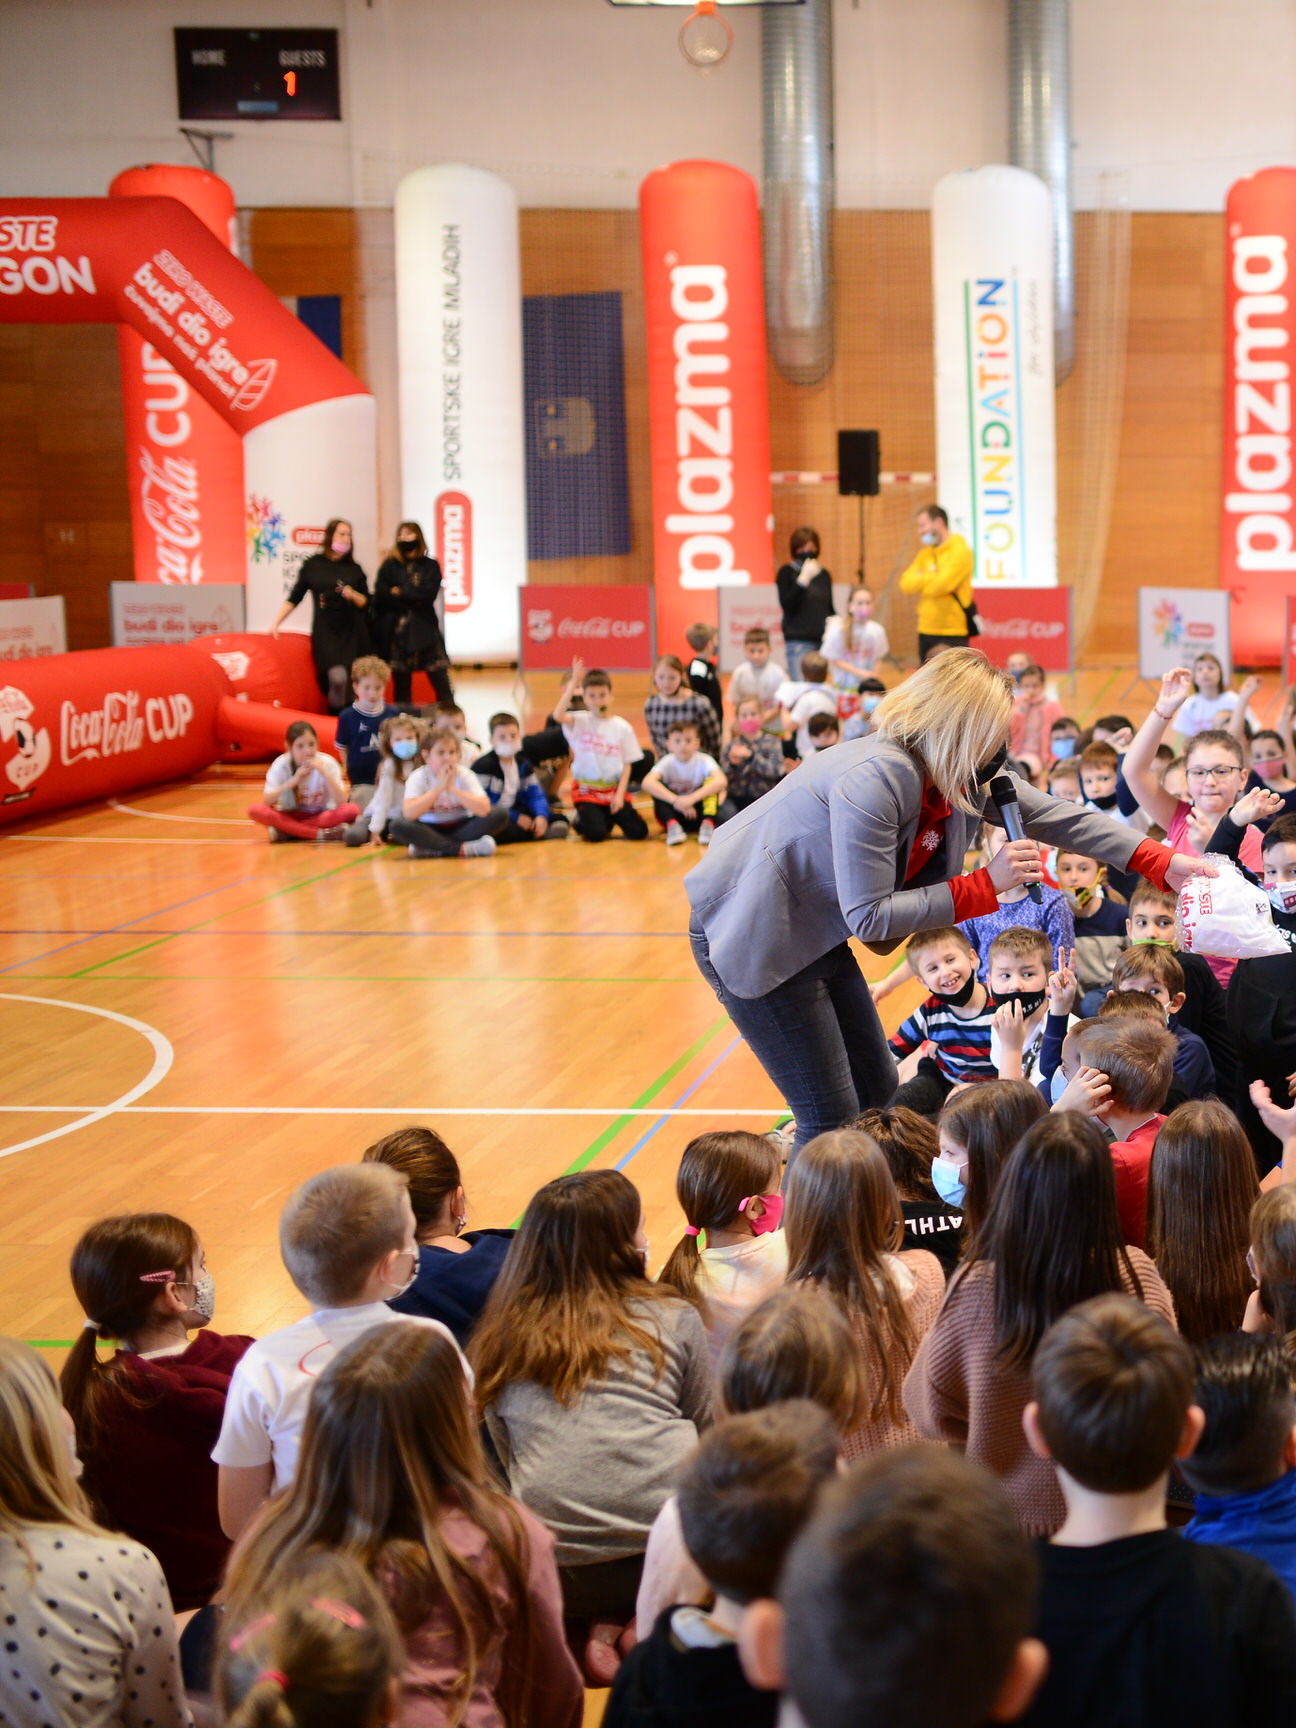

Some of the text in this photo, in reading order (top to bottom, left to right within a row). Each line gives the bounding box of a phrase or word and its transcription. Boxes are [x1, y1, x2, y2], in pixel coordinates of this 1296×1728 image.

[283, 71, 297, 97] 1
[0, 256, 97, 295] GON
[133, 262, 250, 385] budi dio igre
[442, 224, 463, 482] SPORTSKE IGRE MLADIH
[665, 264, 751, 590] plazma
[440, 503, 470, 607] plazma
[612, 619, 645, 638] CUP
[61, 690, 144, 767] Coca-Cola
[145, 693, 194, 744] CUP
